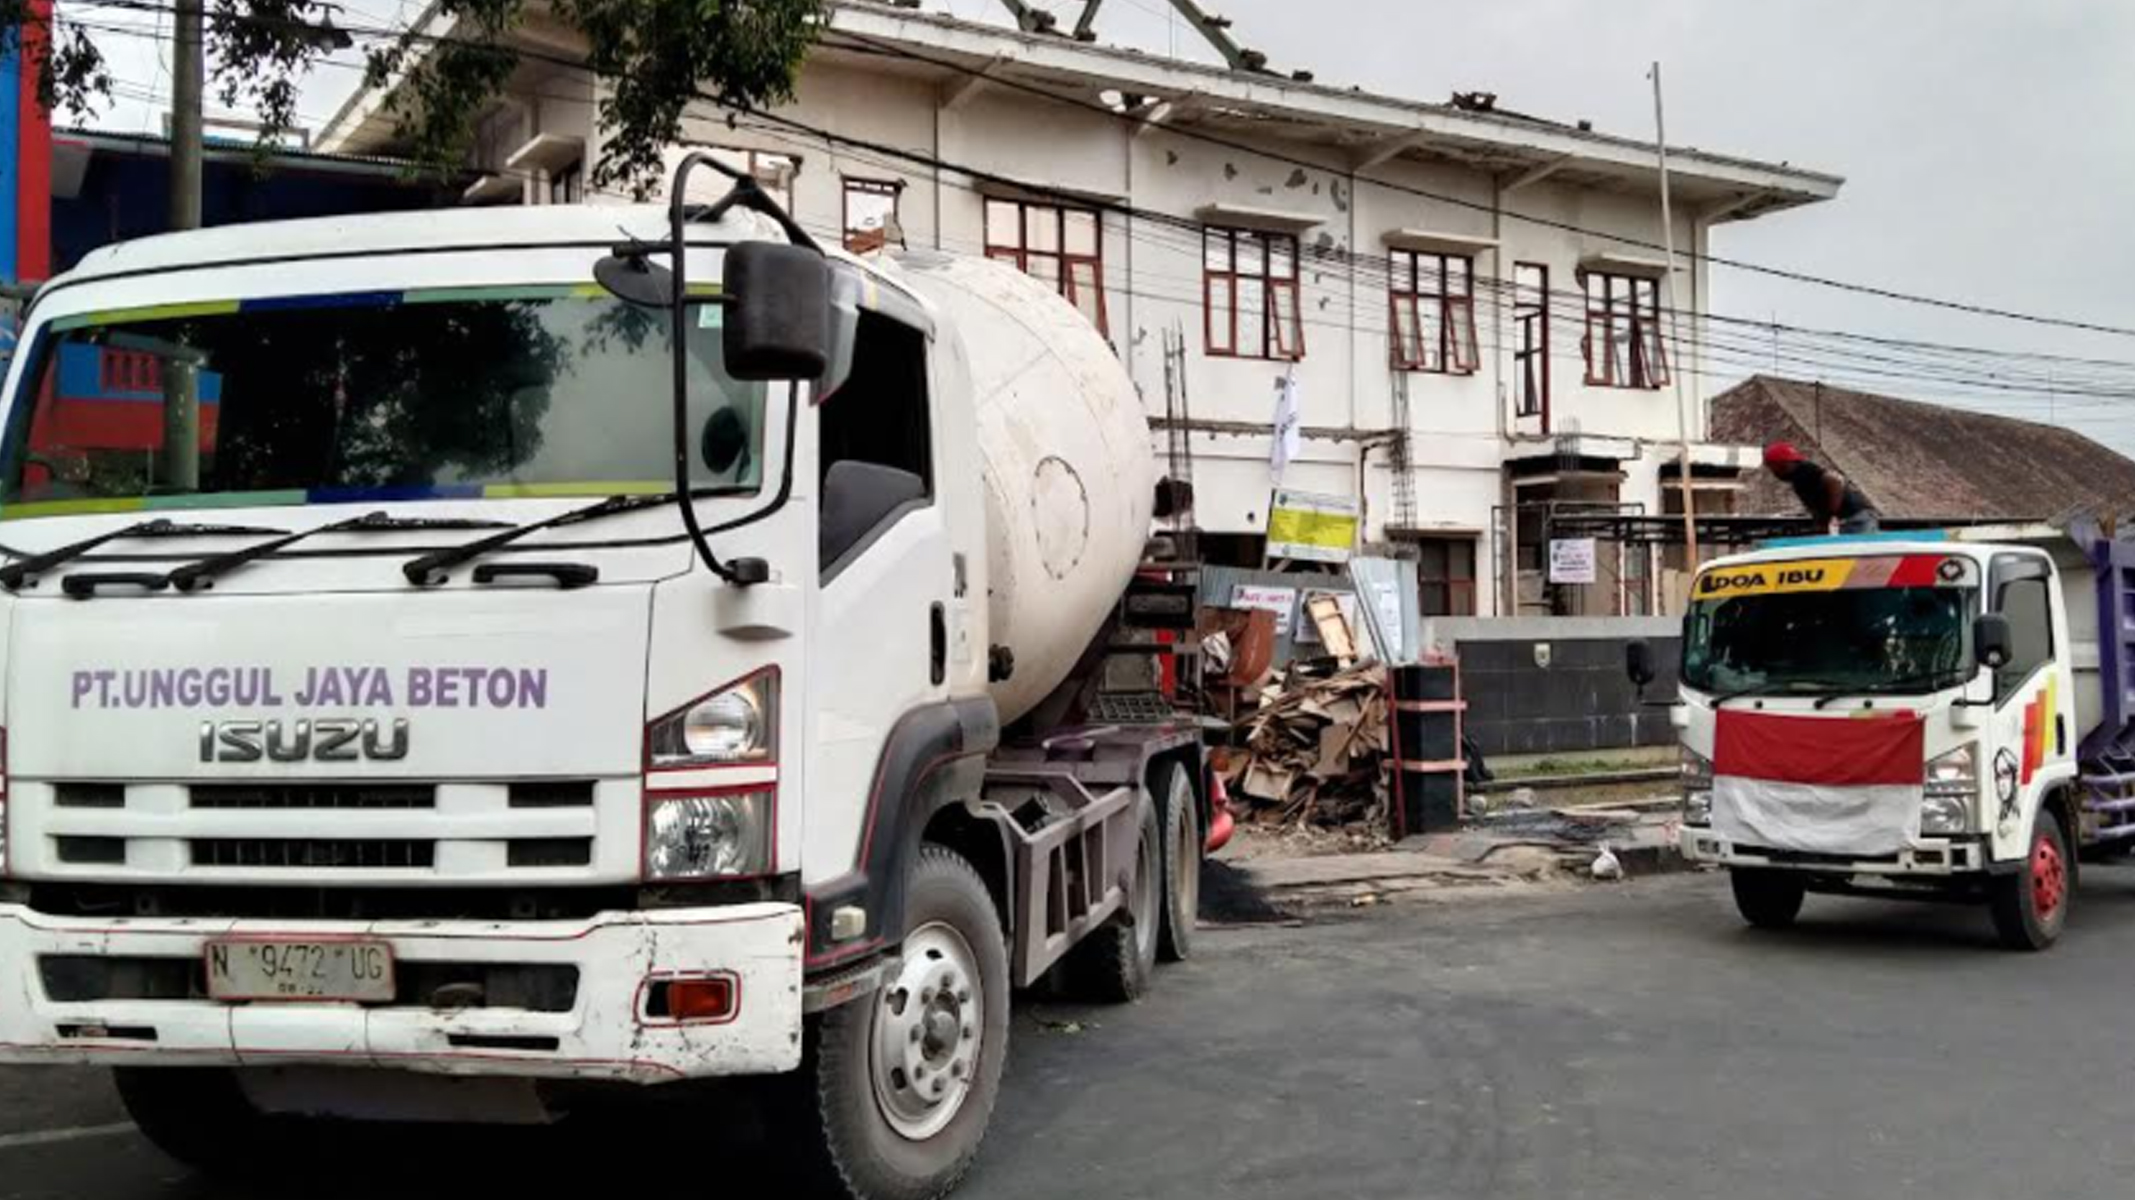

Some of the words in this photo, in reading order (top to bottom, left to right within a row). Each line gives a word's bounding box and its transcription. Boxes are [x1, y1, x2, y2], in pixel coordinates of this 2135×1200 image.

[1778, 569, 1824, 584] IBU
[71, 667, 282, 708] PT.UNGGUL
[294, 666, 393, 707] JAYA
[407, 667, 548, 708] BETON
[199, 718, 409, 762] ISUZU
[212, 945, 229, 977] N
[262, 944, 326, 978] 9472
[352, 946, 383, 980] UG
